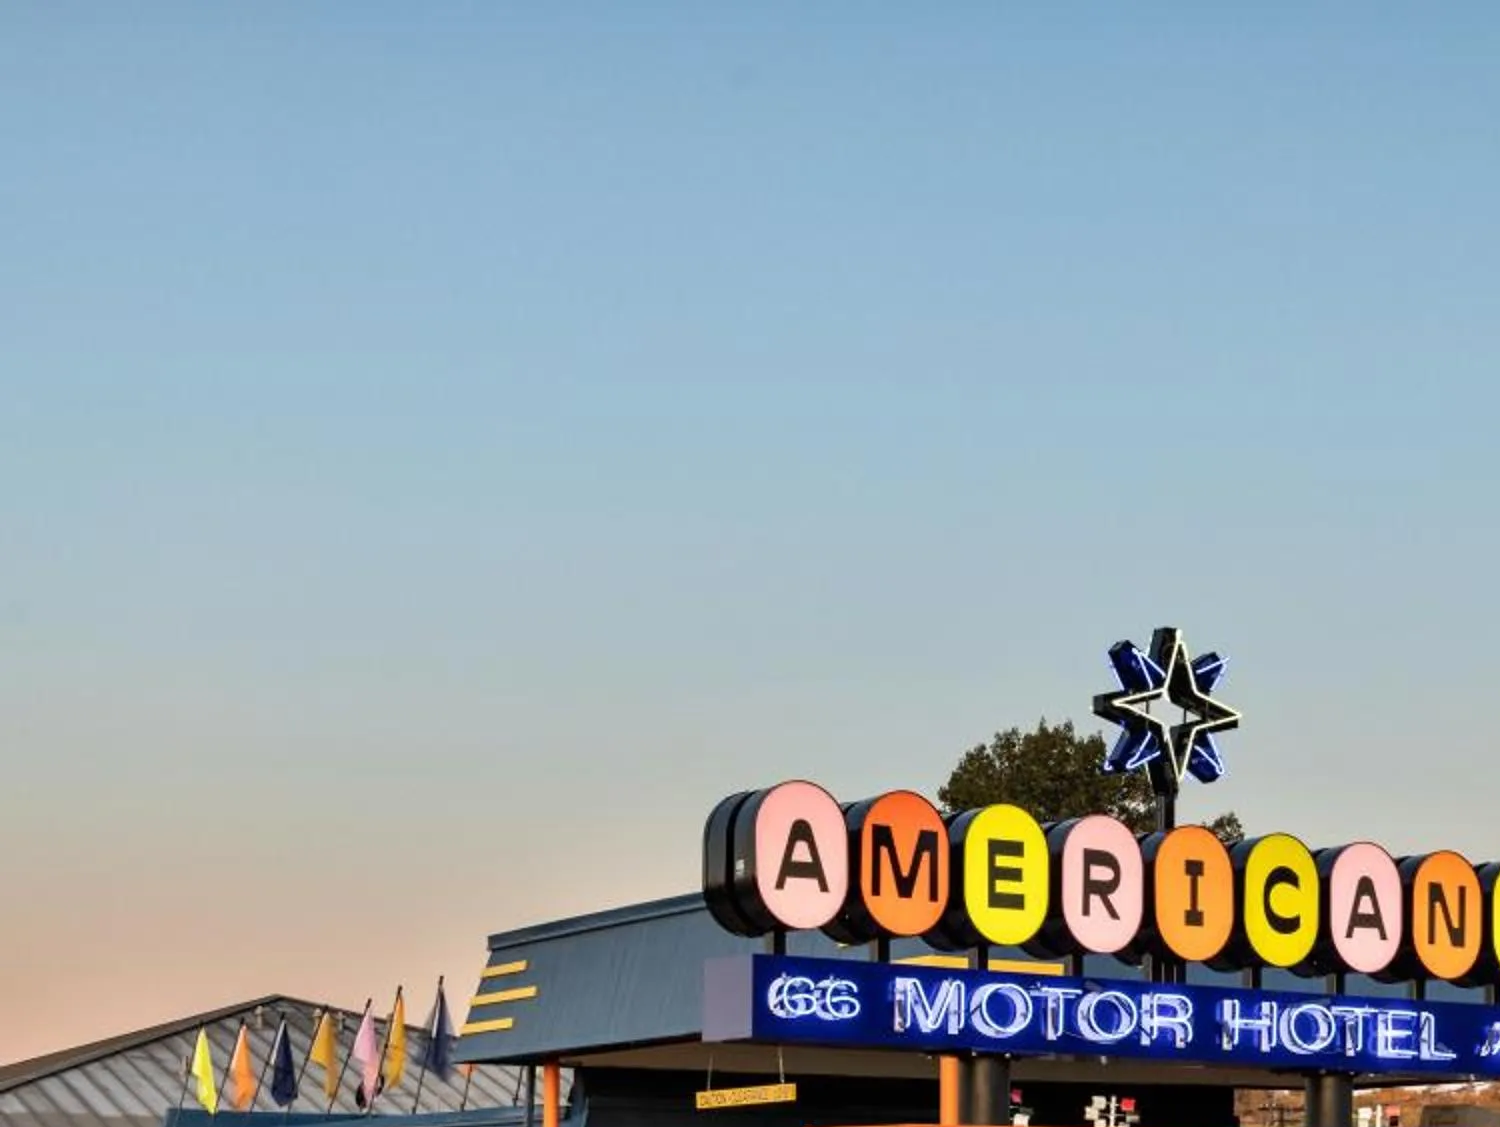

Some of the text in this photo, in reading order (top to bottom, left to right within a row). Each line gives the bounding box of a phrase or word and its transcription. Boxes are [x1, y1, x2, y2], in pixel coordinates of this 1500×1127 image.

[767, 974, 861, 1020] 66
[893, 977, 1195, 1049] MOTOR
[1221, 998, 1457, 1061] HOTEL
